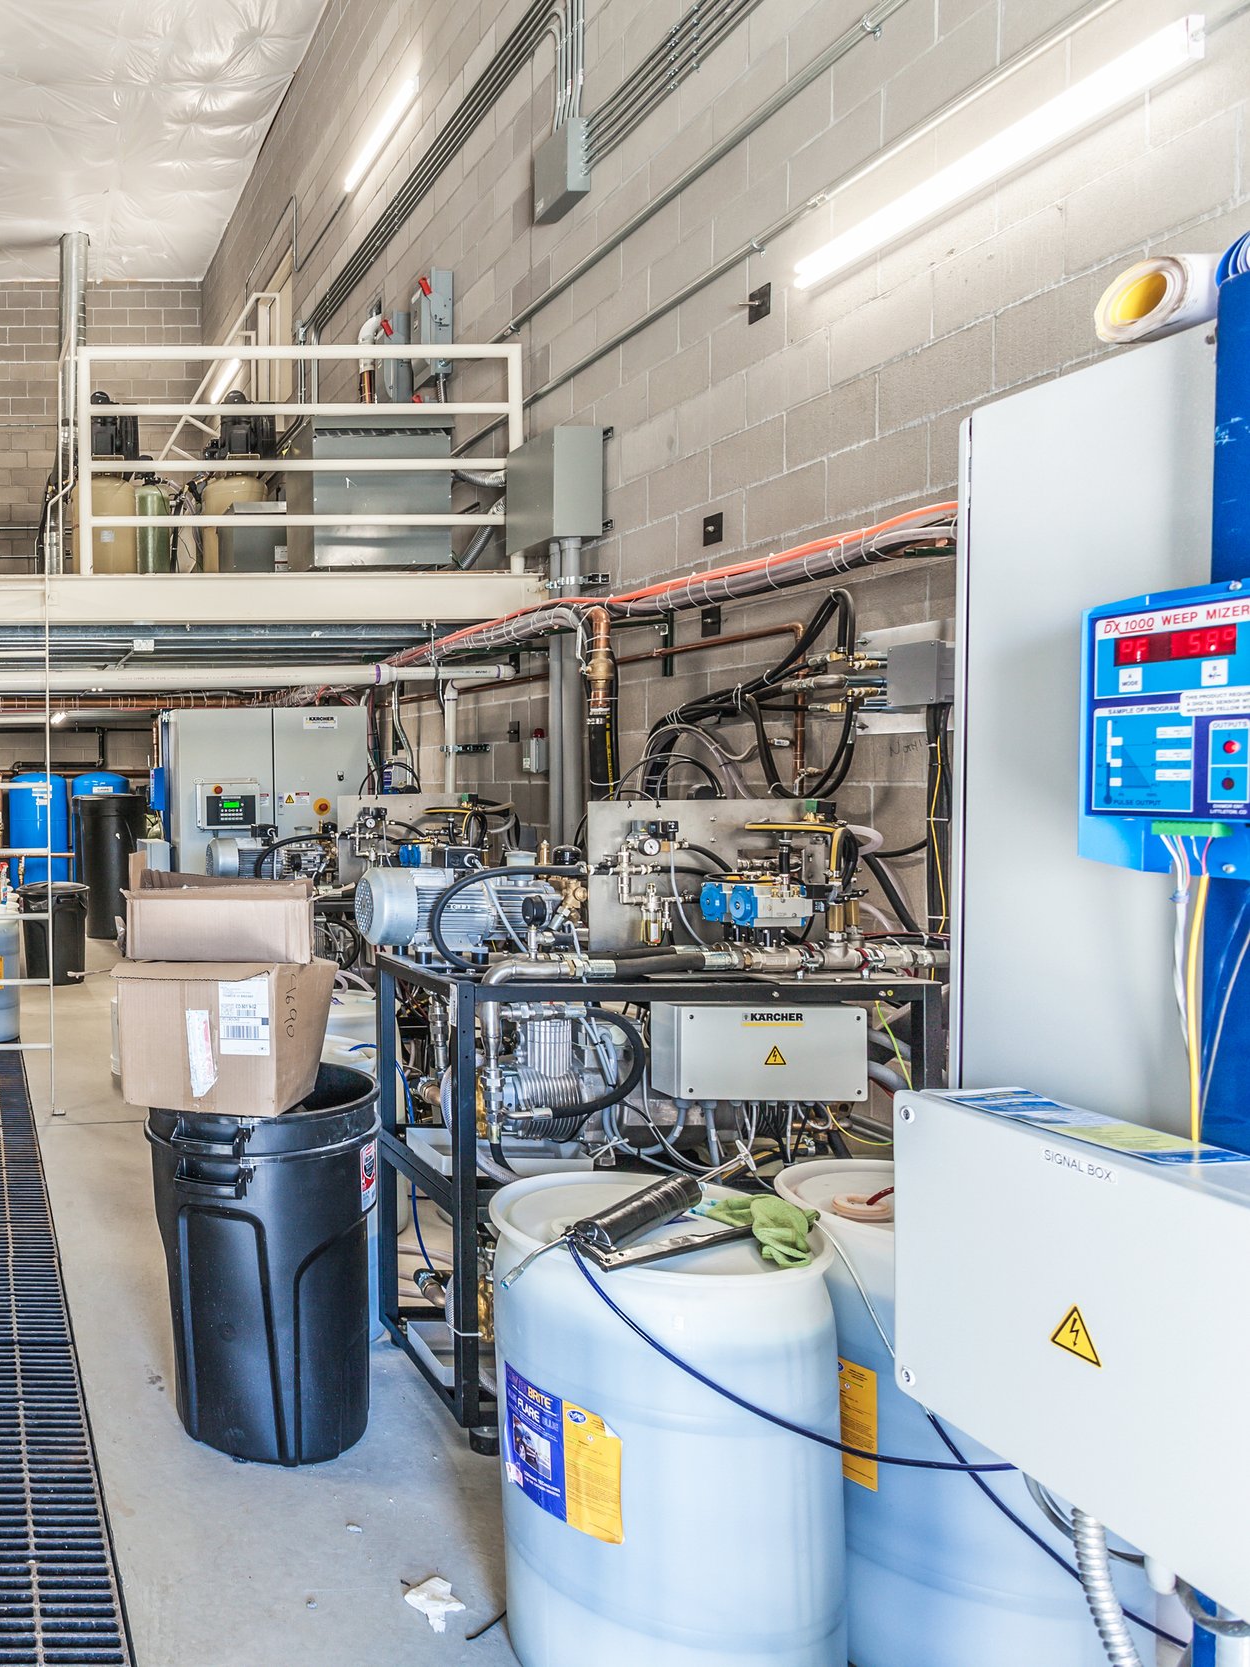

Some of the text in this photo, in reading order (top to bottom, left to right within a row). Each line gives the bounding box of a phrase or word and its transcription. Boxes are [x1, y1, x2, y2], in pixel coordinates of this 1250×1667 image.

[1104, 604, 1250, 635] DX 1000 WEEP MIZER
[1108, 706, 1134, 715] SAMPLE
[750, 1012, 804, 1022] KÄRCHER
[1044, 1149, 1112, 1182] SIGNAL BOX
[517, 1397, 540, 1423] FLARE
